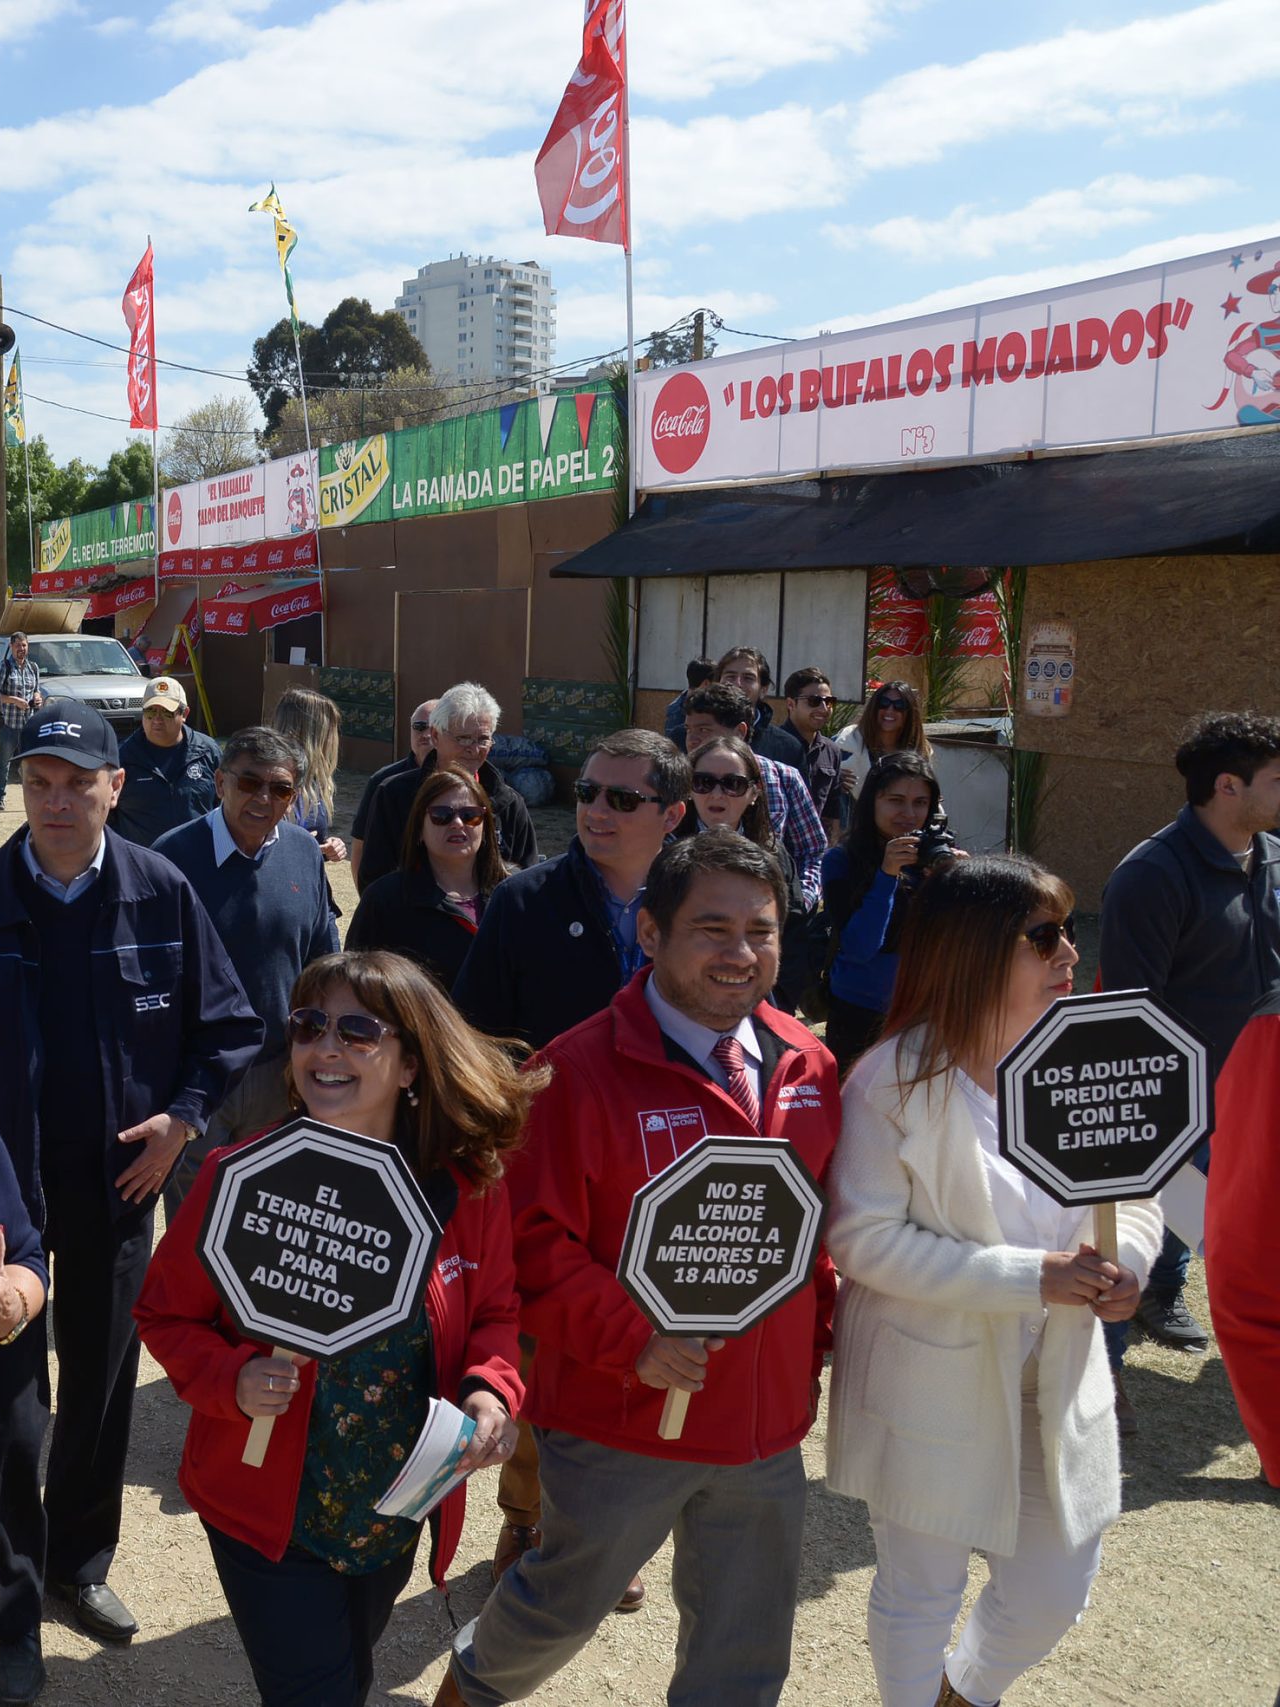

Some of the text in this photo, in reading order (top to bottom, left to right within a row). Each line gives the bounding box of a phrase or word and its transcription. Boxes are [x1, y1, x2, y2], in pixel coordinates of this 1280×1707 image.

[799, 344, 954, 412] BUFALOS
[653, 403, 708, 441] Coca-Cola
[320, 450, 382, 515] CRISTAL
[392, 445, 615, 510] LA RAMADA DE PAPEL 2
[217, 504, 229, 523] DEL
[41, 528, 69, 565] CRISTAL
[72, 531, 155, 563] EL REY DEL TERREMOTO
[271, 595, 311, 618] Coca-Cola
[37, 721, 82, 739] SEC
[135, 993, 170, 1013] SEC
[1032, 1054, 1179, 1087] LOS ADULTOS
[1050, 1078, 1162, 1107] PREDICAN
[1067, 1103, 1146, 1127] CON EL
[1057, 1123, 1158, 1150] EJEMPLO
[315, 1184, 343, 1209] EL
[706, 1182, 767, 1200] NO SE
[256, 1190, 392, 1249] TERREMOTO
[698, 1204, 766, 1222] VENDE
[241, 1211, 391, 1275] ES UN TRAGO
[669, 1224, 780, 1243] ALCOHOL A
[278, 1248, 338, 1284] PARA
[656, 1246, 785, 1265] MENORES DE
[673, 1264, 759, 1284] 18 AÑOS
[249, 1265, 355, 1314] ADULTOS
